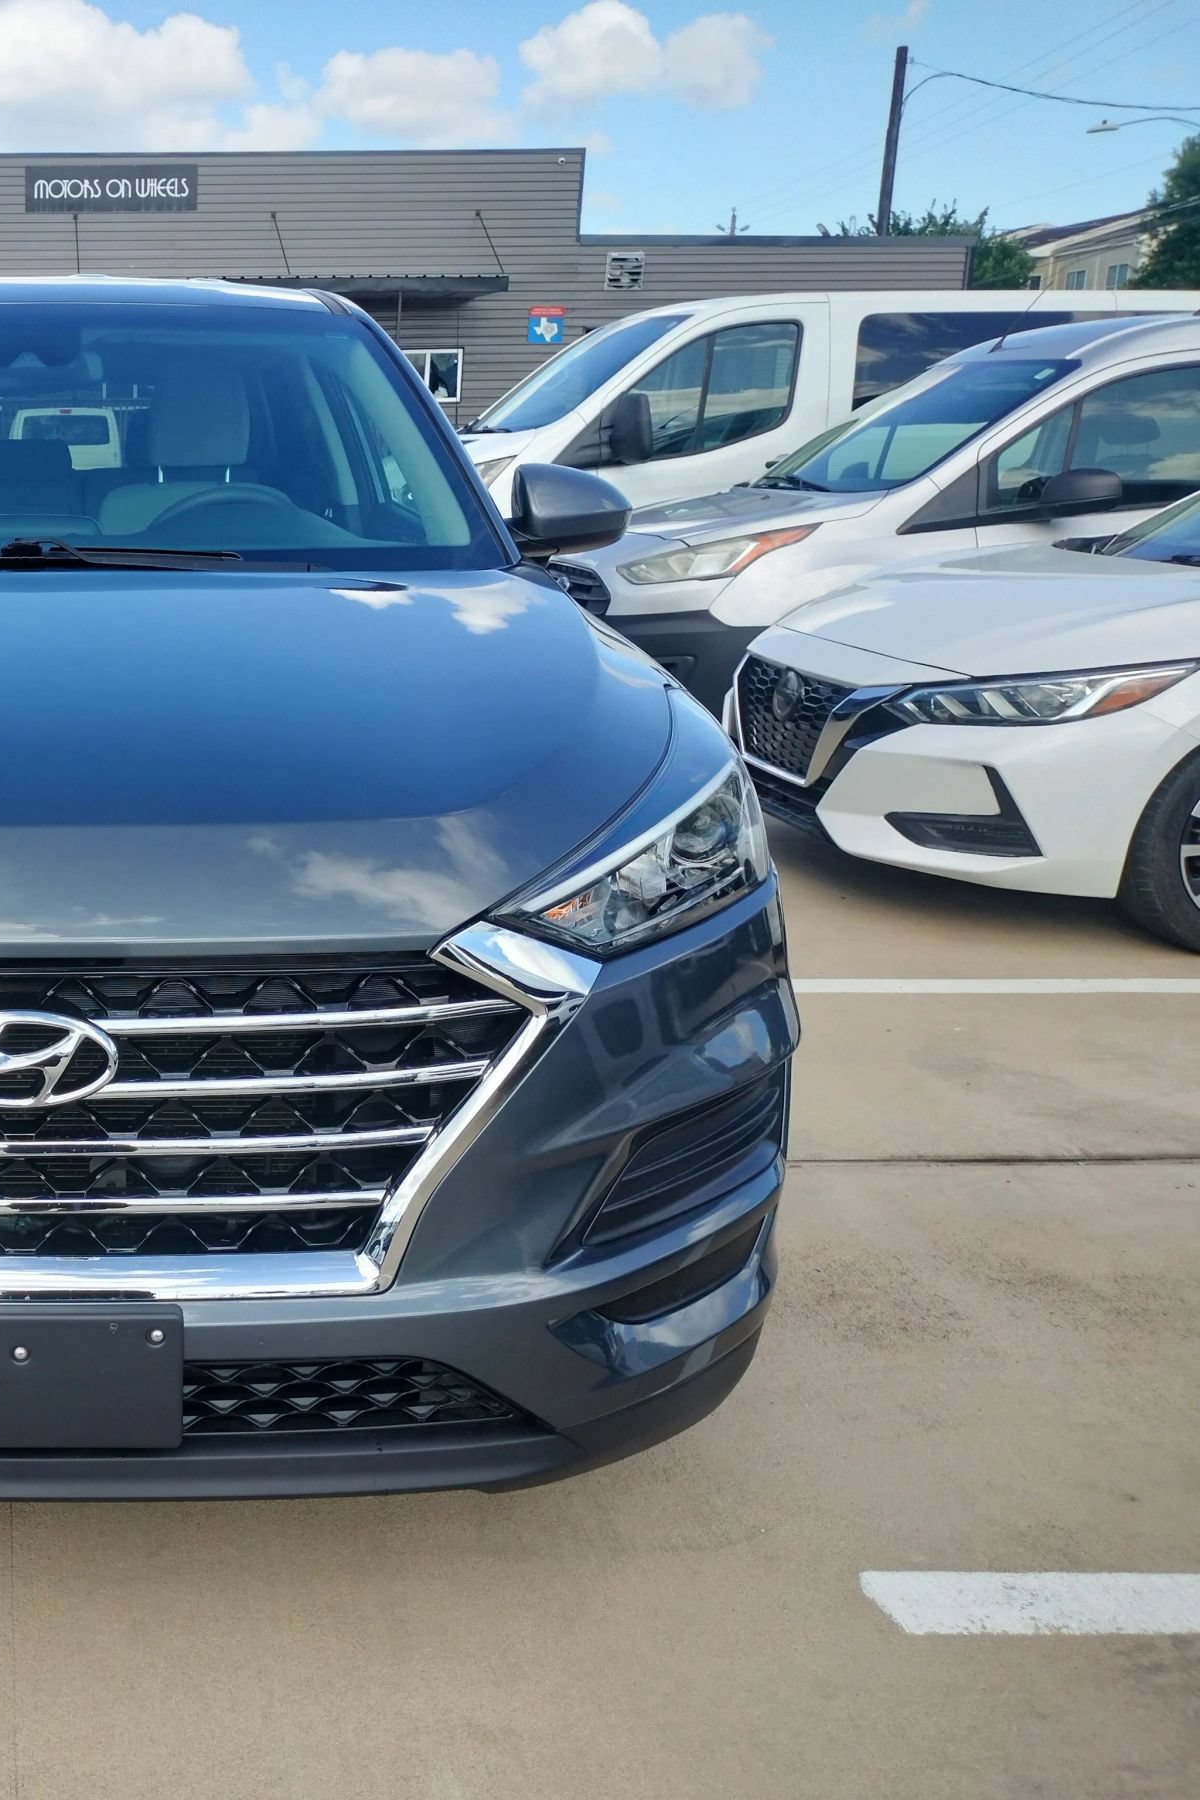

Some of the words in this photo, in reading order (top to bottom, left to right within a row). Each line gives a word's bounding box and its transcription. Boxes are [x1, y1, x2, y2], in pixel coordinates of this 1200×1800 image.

[33, 178, 102, 199] MOTORS
[105, 178, 132, 198] ON
[135, 177, 190, 198] WHEELS
